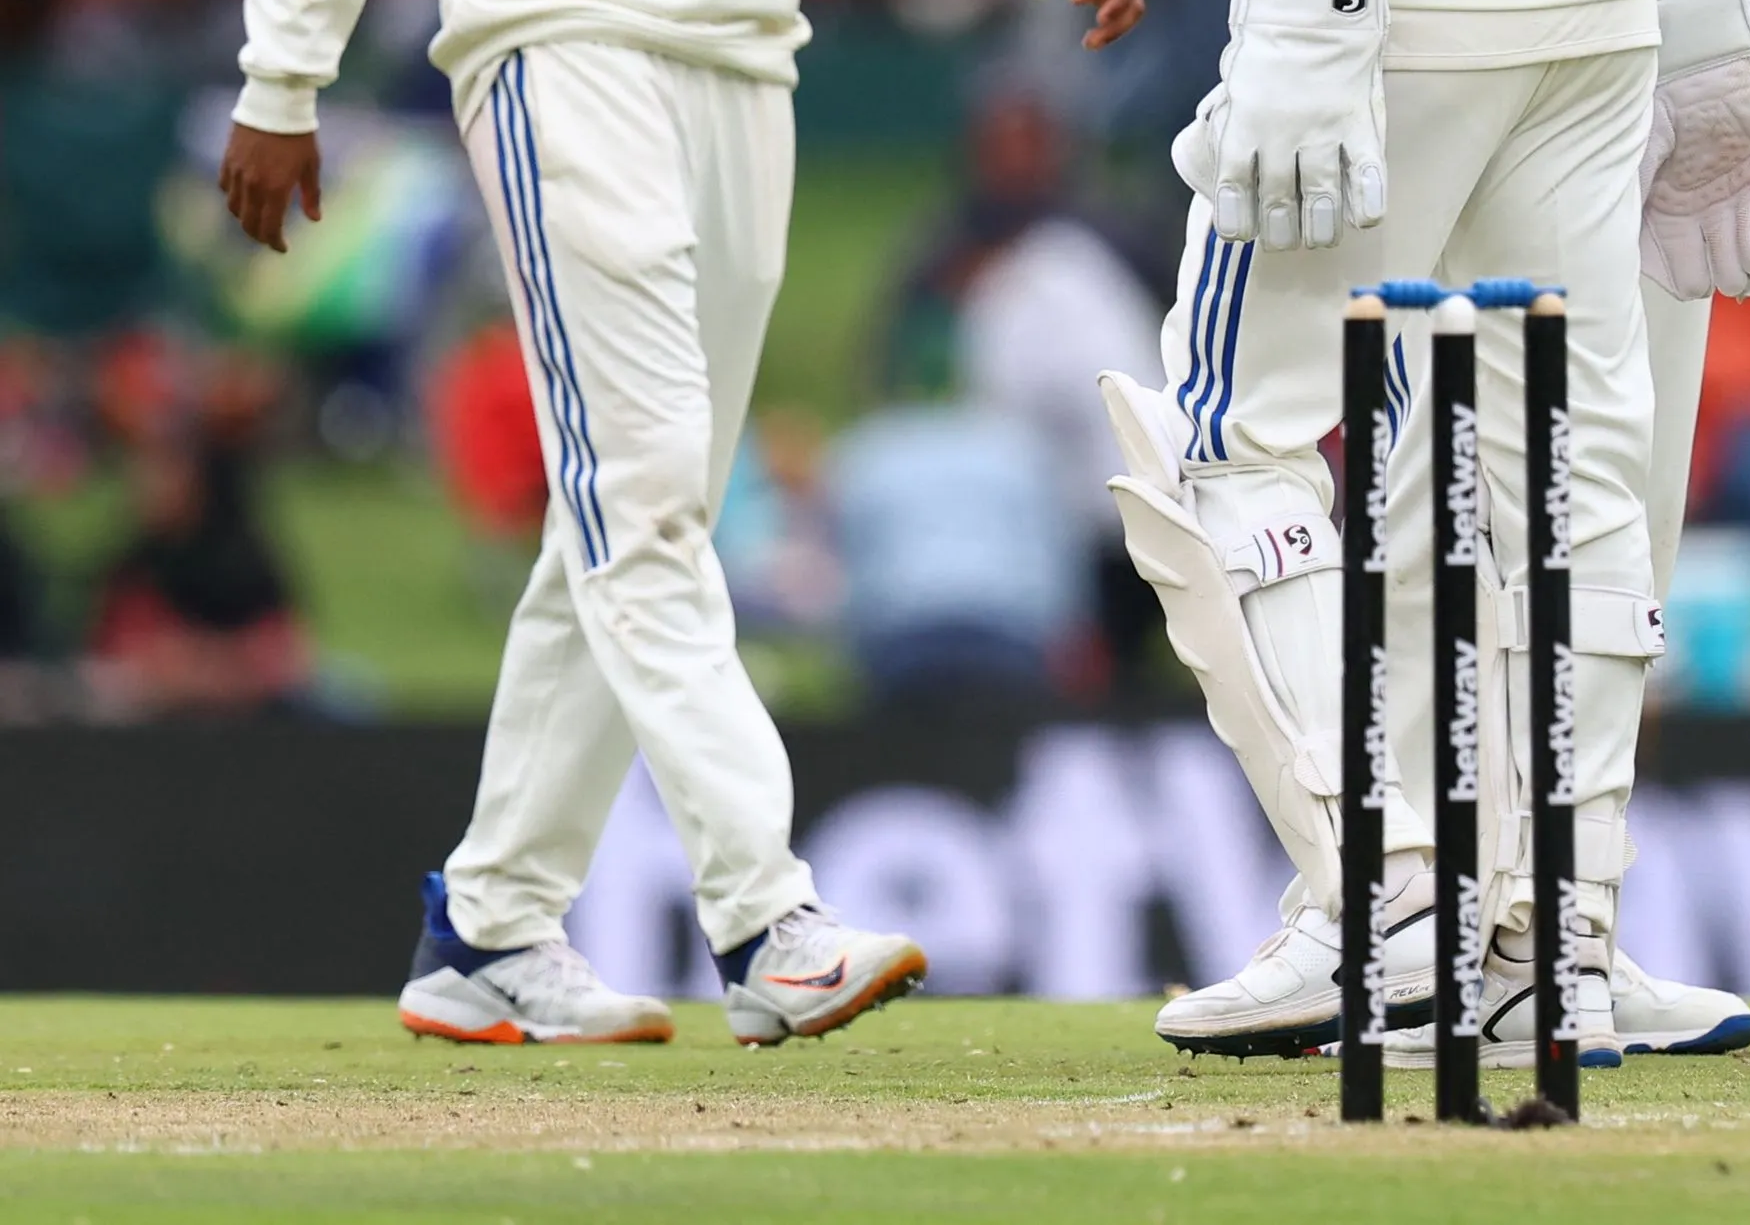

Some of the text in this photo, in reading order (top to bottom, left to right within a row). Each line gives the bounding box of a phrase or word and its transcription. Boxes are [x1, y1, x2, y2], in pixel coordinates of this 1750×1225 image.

[1445, 402, 1478, 567] betway
[1543, 406, 1570, 570] betway
[1448, 637, 1478, 802] betway
[1547, 641, 1575, 805] betway
[1452, 873, 1481, 1037] betway
[1552, 877, 1578, 1041] betway
